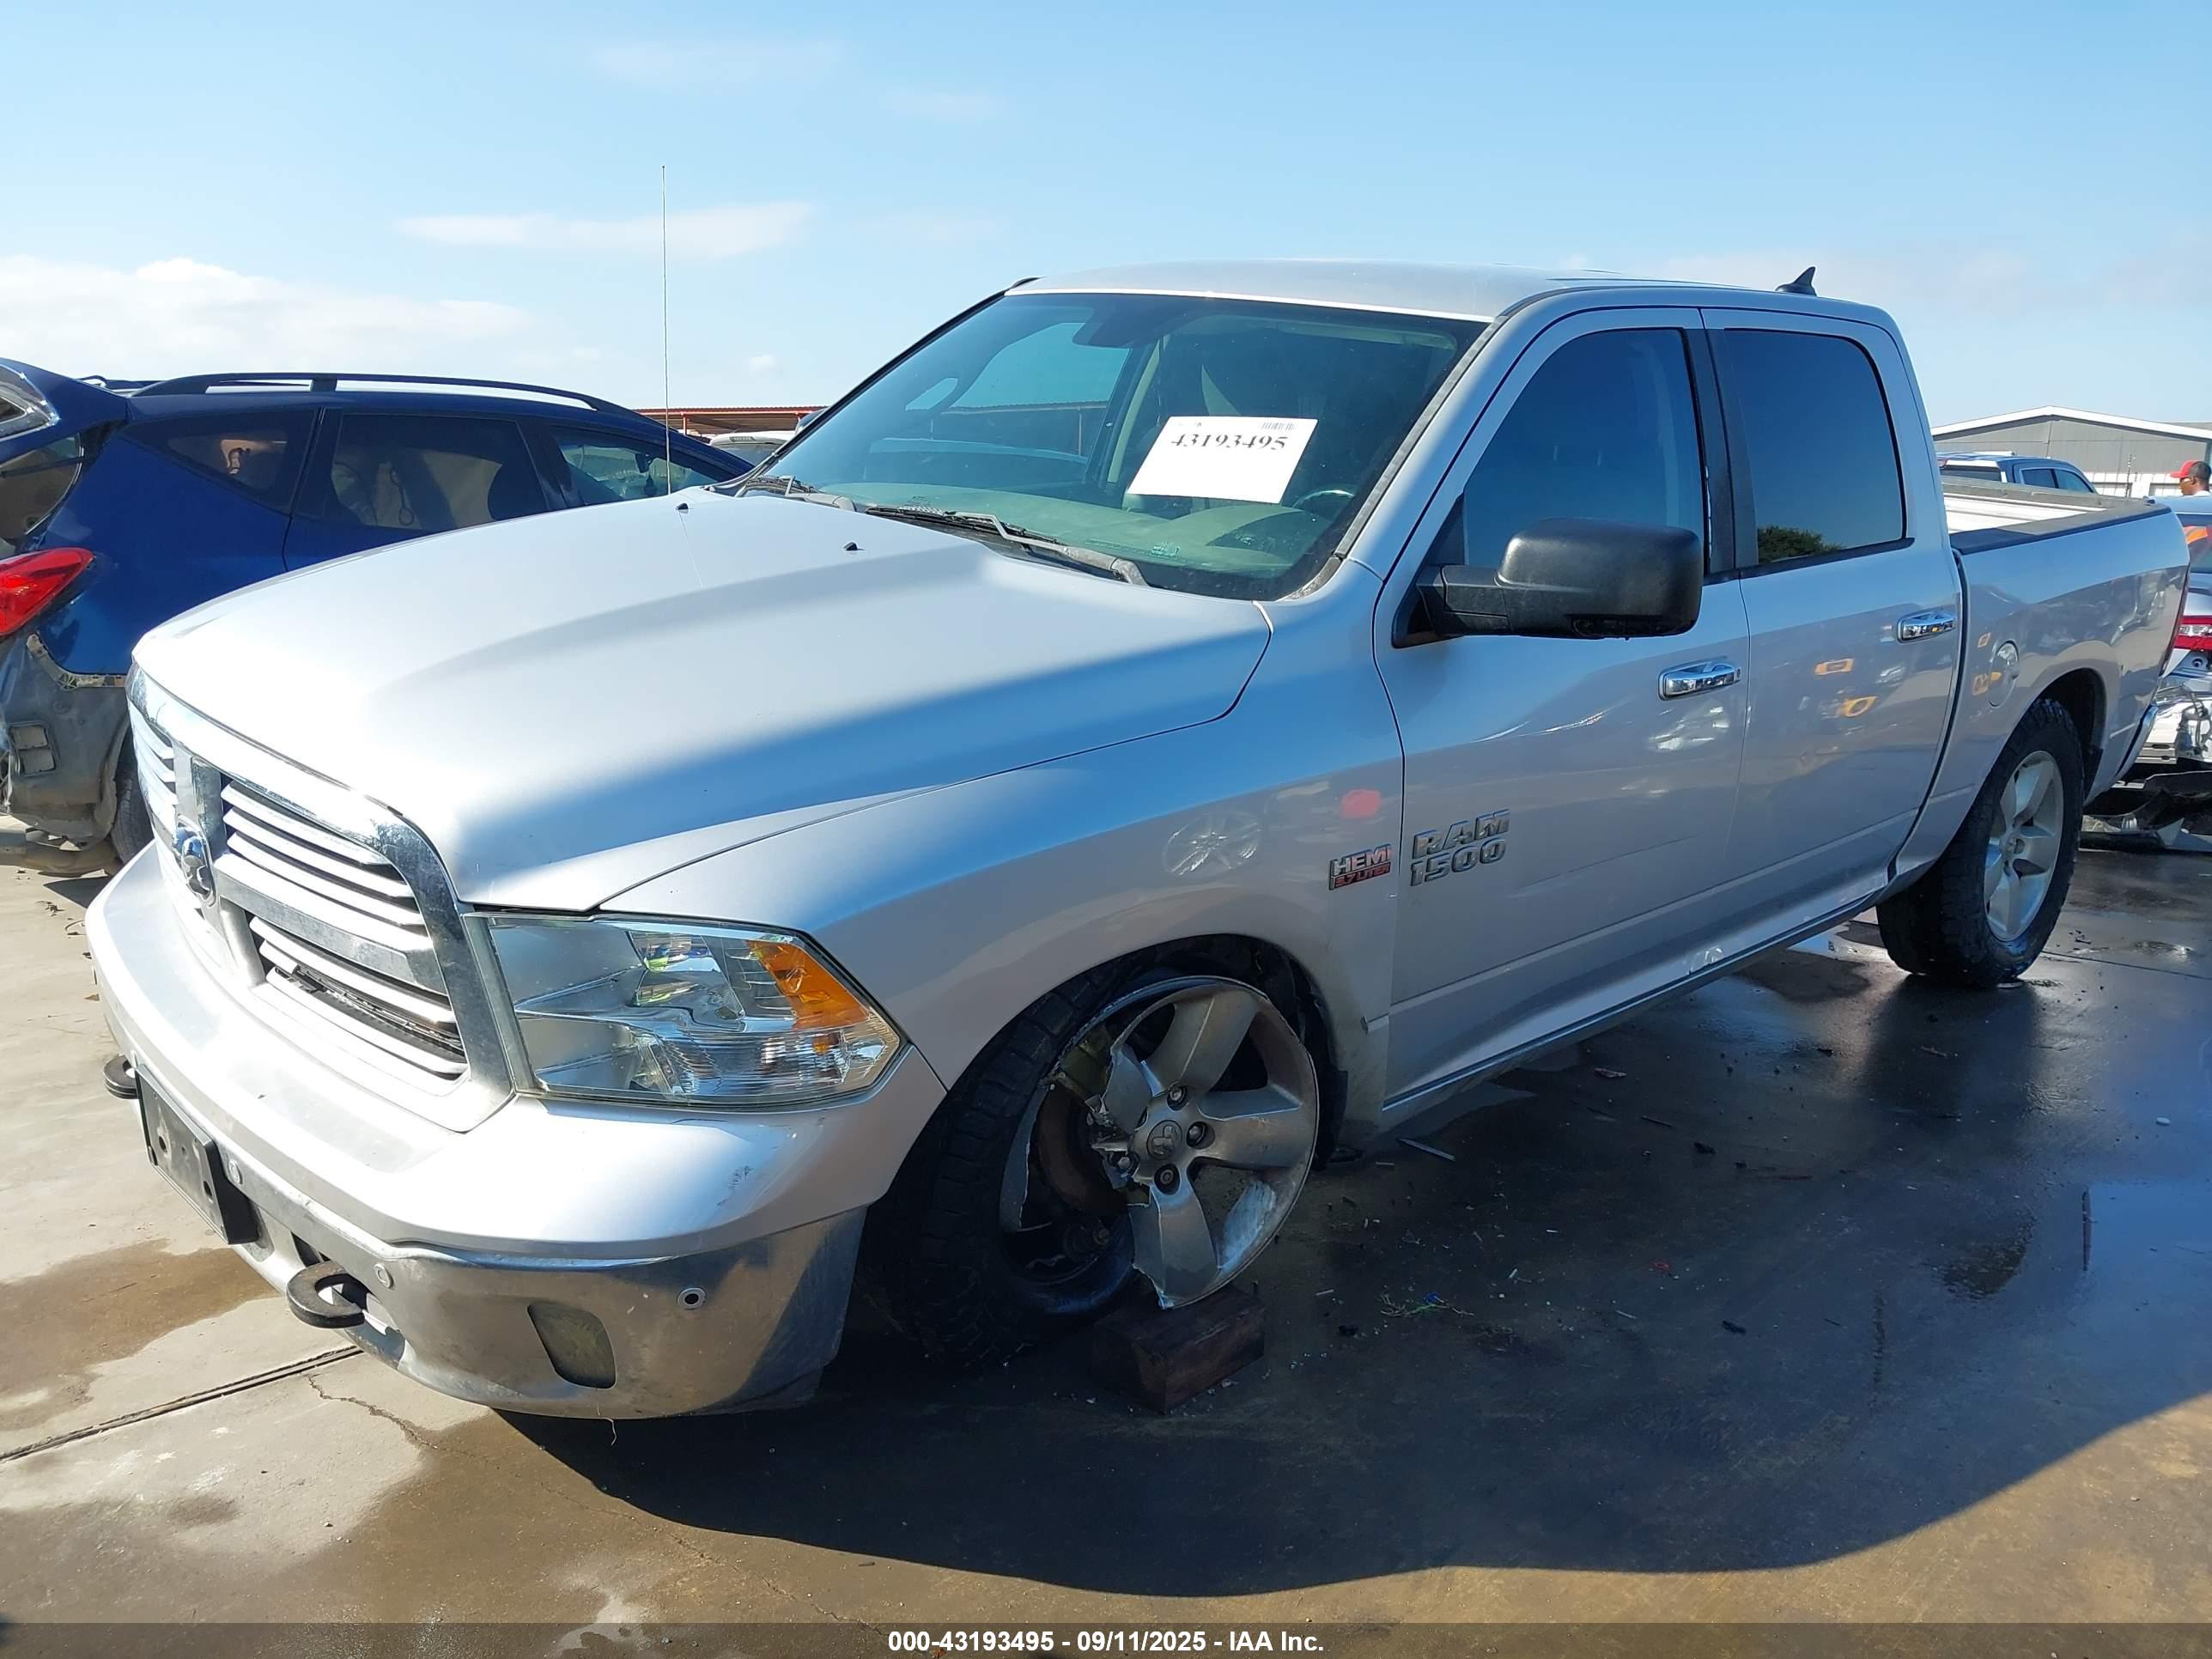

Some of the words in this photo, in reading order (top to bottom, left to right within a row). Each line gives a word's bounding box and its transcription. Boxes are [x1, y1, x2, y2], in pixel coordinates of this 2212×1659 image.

[1170, 433, 1289, 451] 43193495
[1413, 809, 1510, 859] RAM
[1330, 843, 1393, 876] HEMI
[1410, 836, 1507, 886] 1500
